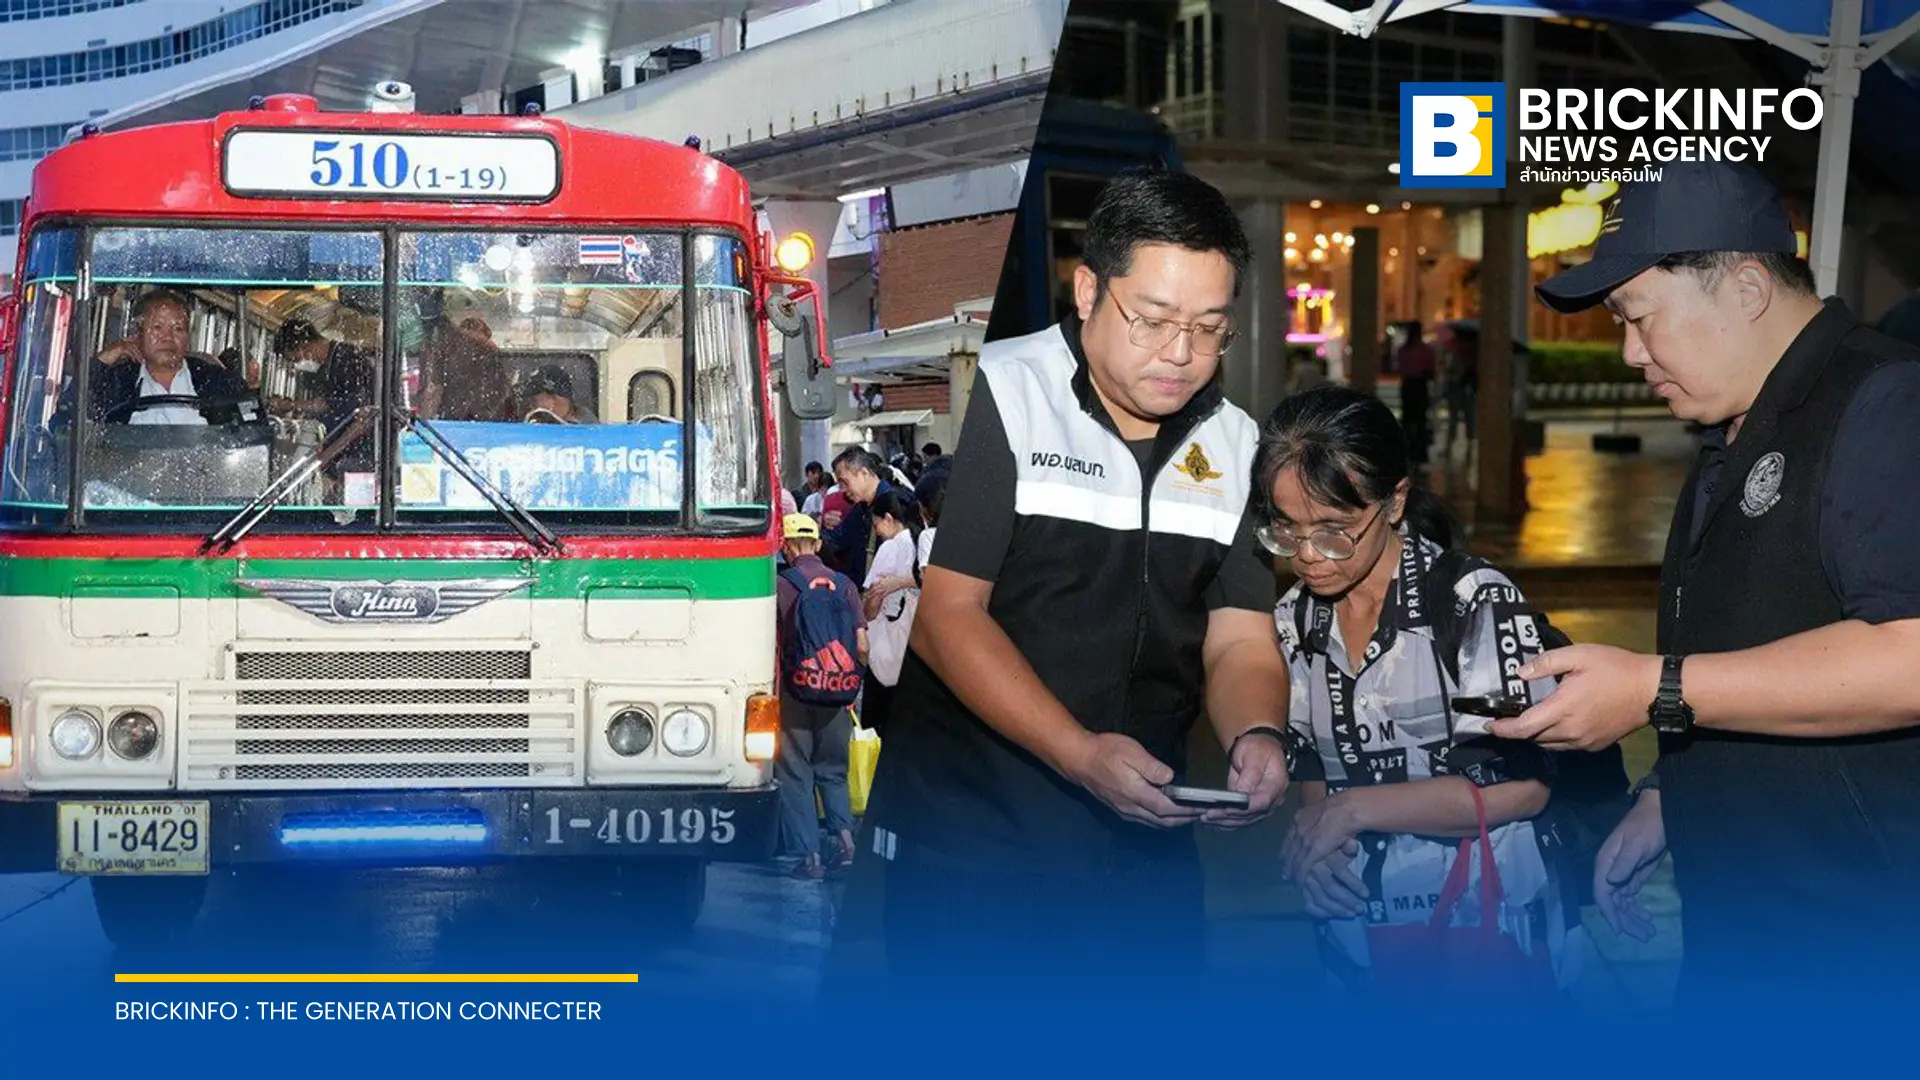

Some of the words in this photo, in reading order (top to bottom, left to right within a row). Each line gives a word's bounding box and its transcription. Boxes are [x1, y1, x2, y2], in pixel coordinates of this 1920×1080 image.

[310, 140, 409, 188] 510
[413, 164, 507, 190] (1-19)
[793, 666, 861, 691] adidas
[93, 805, 173, 816] THAILAND
[545, 807, 736, 844] 1-40195
[73, 819, 199, 853] 11-8429
